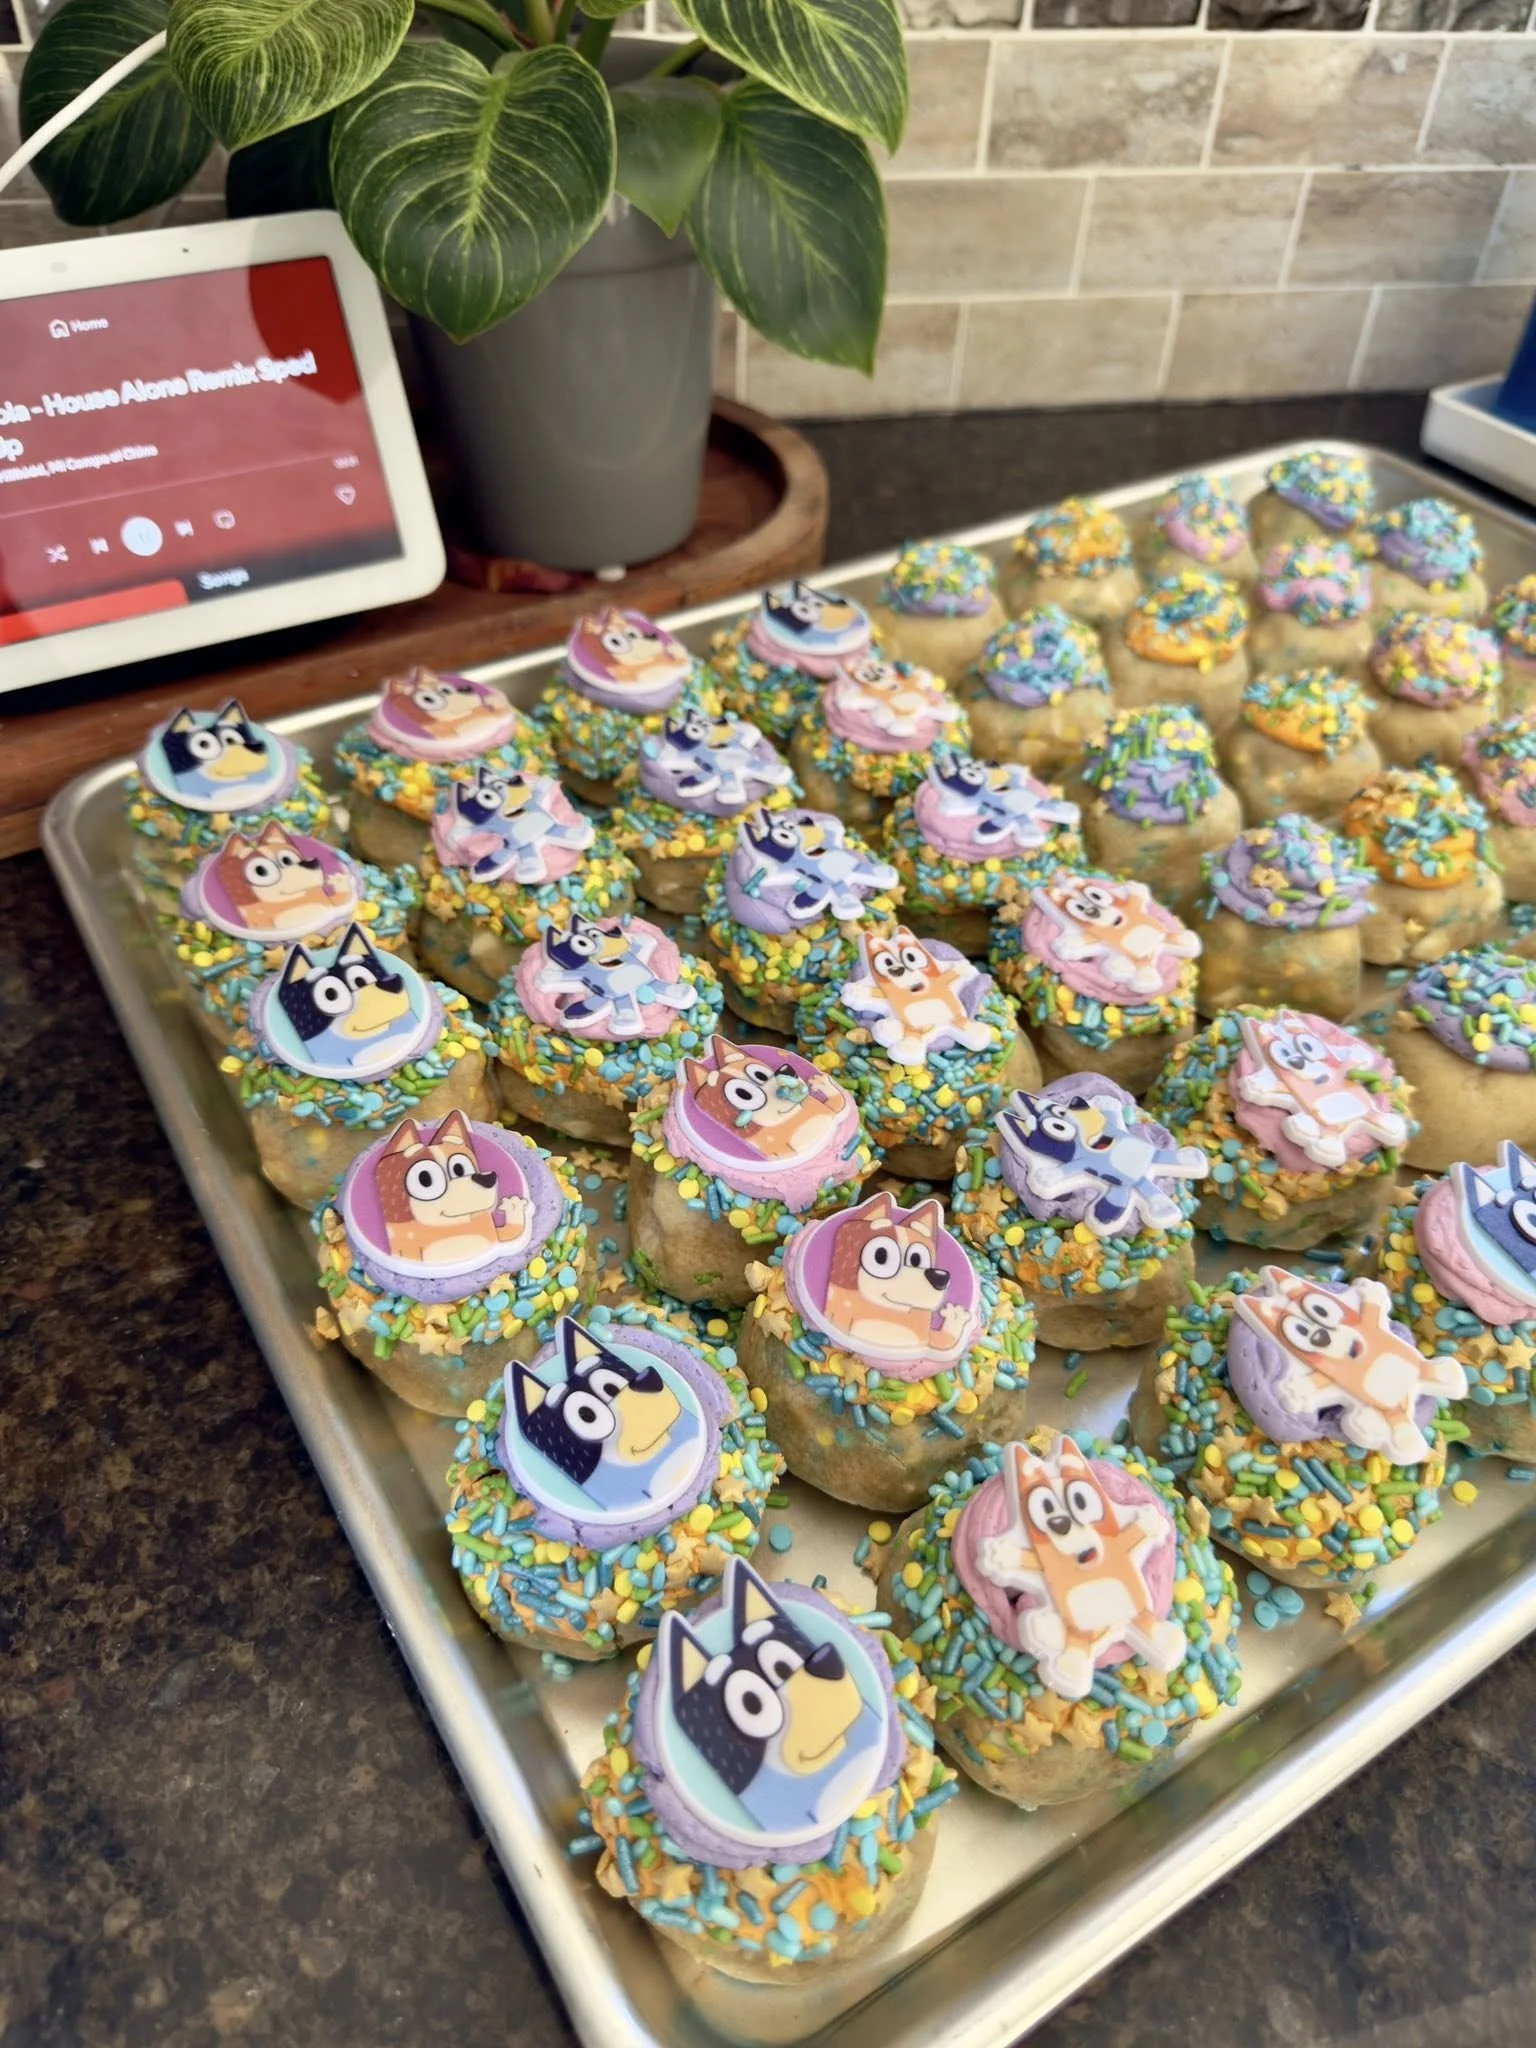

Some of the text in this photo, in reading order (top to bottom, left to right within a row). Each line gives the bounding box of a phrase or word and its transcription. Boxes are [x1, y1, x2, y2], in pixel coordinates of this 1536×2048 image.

[69, 318, 109, 333] Home
[42, 388, 120, 417] House
[120, 377, 189, 404] Alone
[185, 361, 260, 393] Remix
